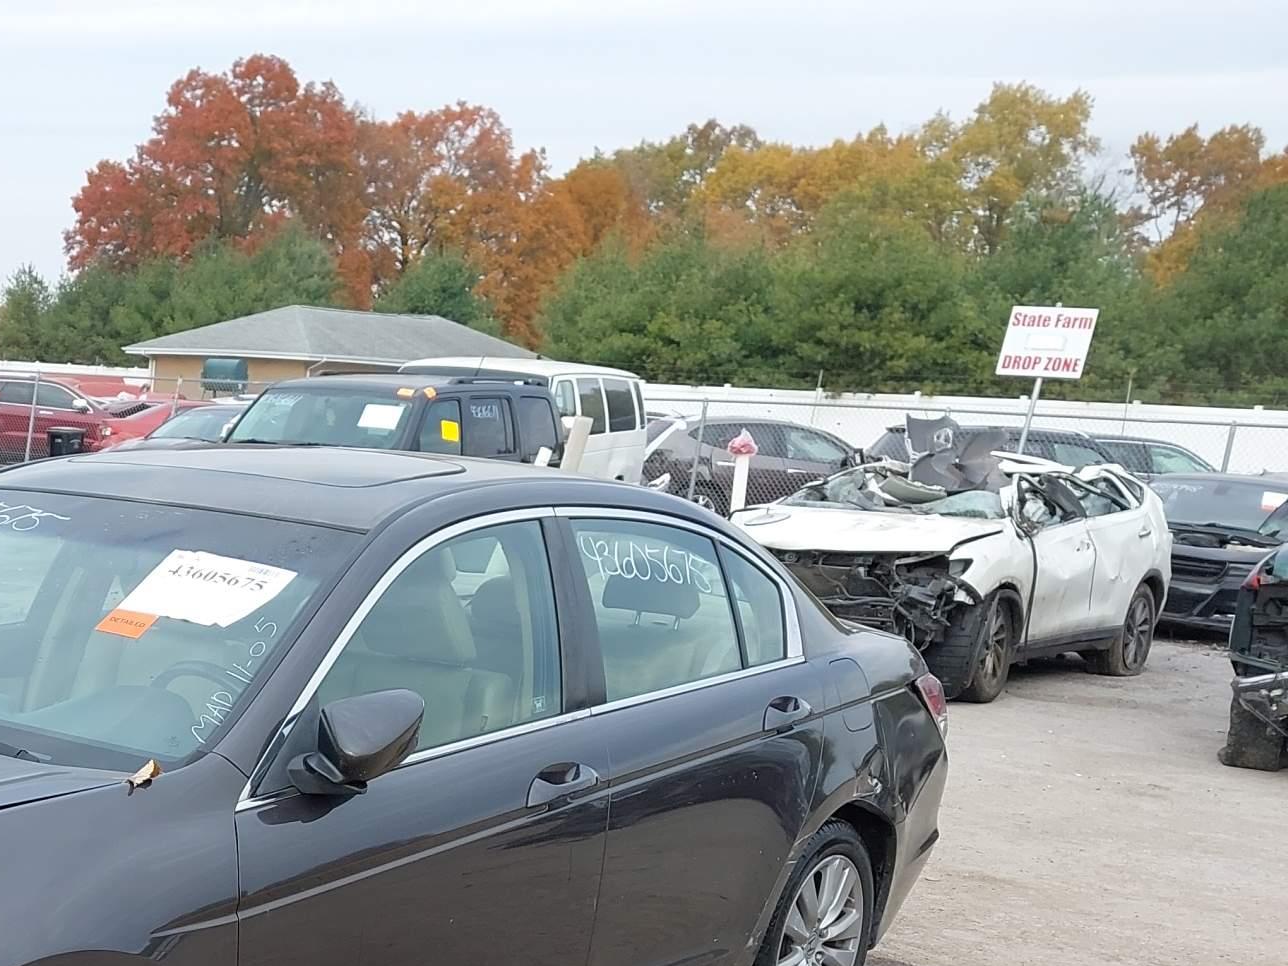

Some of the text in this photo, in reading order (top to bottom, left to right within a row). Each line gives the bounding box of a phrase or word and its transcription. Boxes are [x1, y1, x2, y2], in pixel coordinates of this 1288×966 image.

[1012, 312, 1094, 330] State Farm
[1001, 355, 1081, 373] DROP ZONE
[580, 536, 712, 593] 43605675
[168, 565, 268, 592] 43605675
[109, 616, 146, 628] DETAILED
